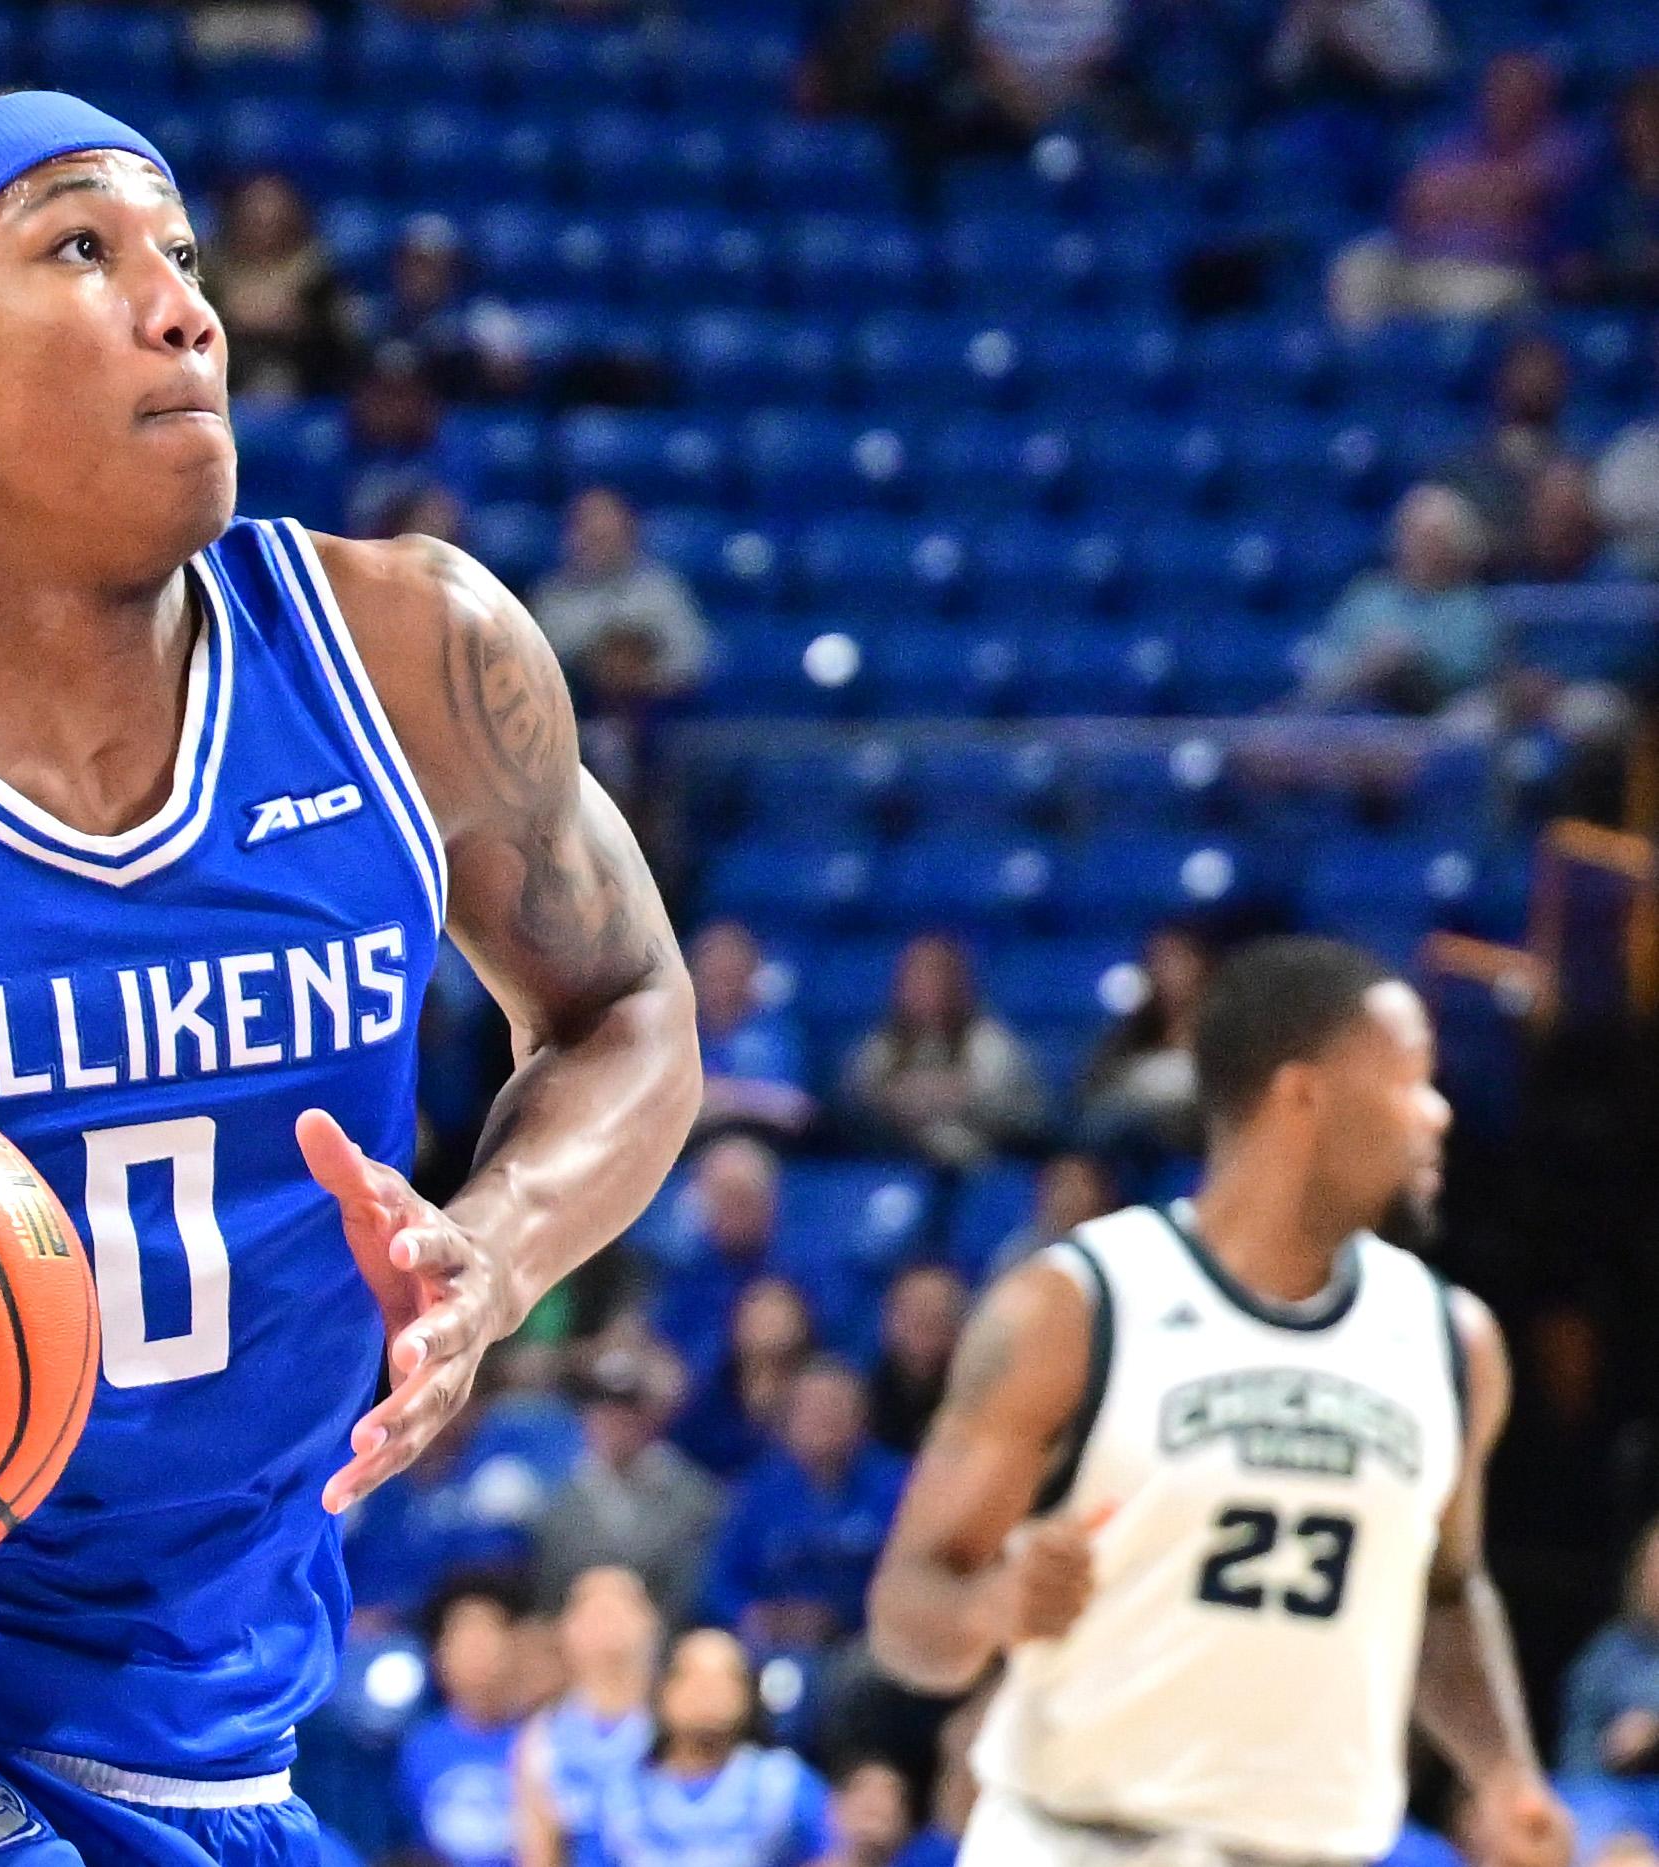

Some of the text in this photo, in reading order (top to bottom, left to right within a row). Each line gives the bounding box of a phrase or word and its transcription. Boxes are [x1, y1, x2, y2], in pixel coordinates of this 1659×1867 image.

[246, 783, 363, 844] A10
[82, 1115, 231, 1389] 0
[1196, 1507, 1358, 1620] 23
